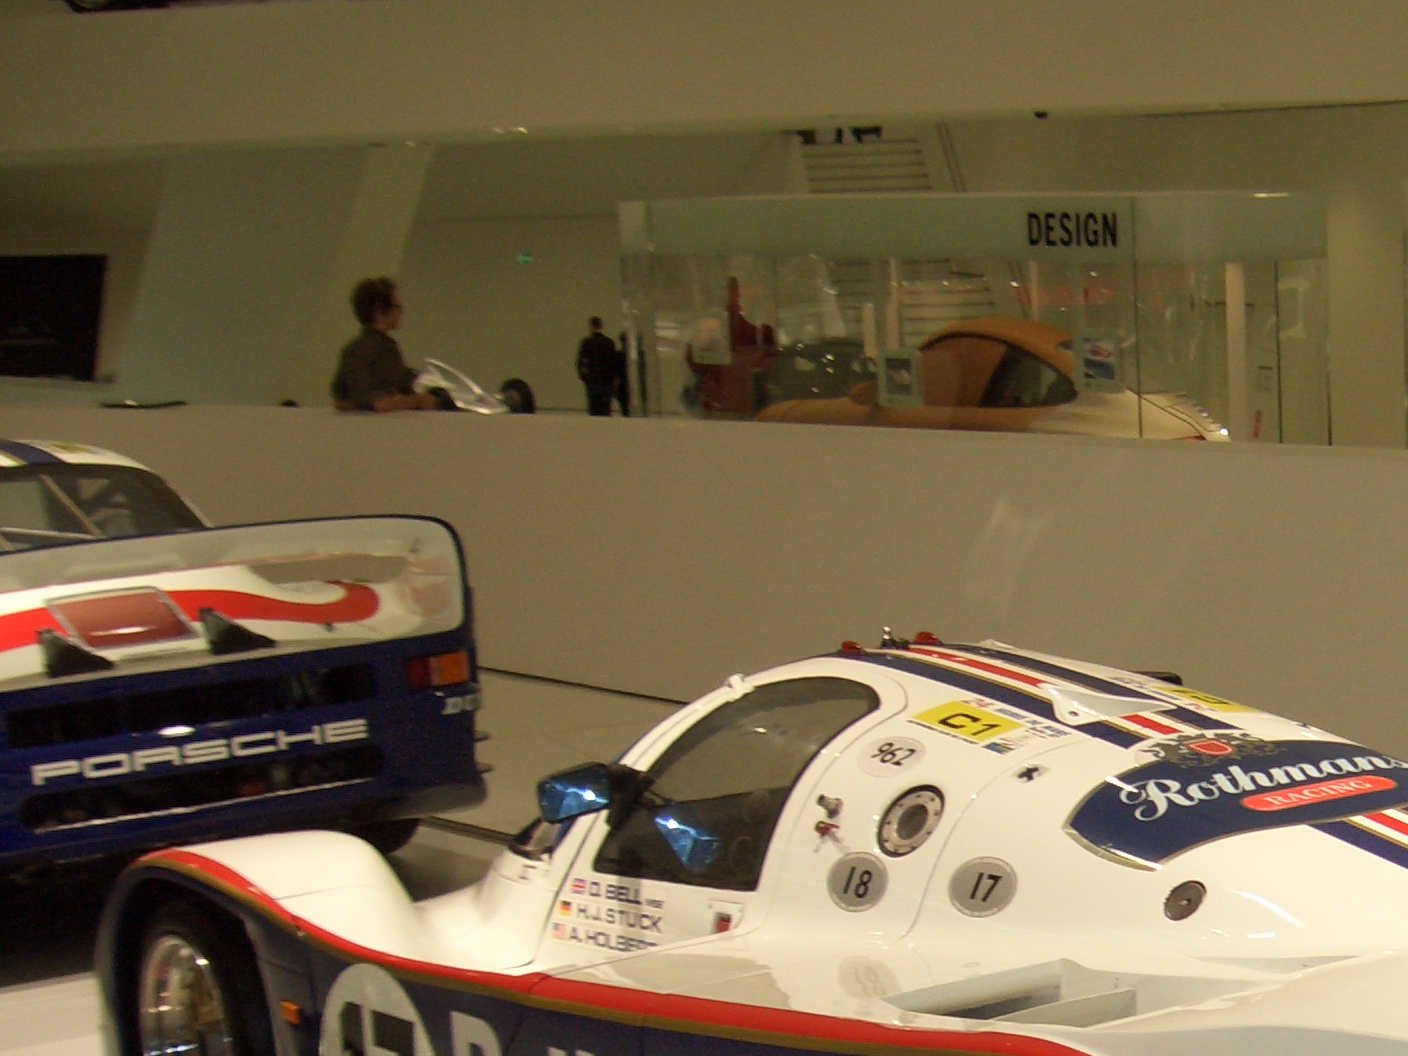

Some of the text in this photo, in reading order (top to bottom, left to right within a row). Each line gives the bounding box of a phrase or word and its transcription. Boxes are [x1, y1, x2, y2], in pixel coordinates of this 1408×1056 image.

[1027, 211, 1118, 247] DESIGN
[938, 713, 1001, 737] C1
[29, 718, 369, 786] PORSCHE
[871, 742, 917, 767] 962
[1264, 779, 1373, 807] RACING
[605, 884, 642, 905] BELL
[843, 865, 872, 899] 18
[969, 871, 1002, 902] 17
[605, 908, 664, 934] STUCK
